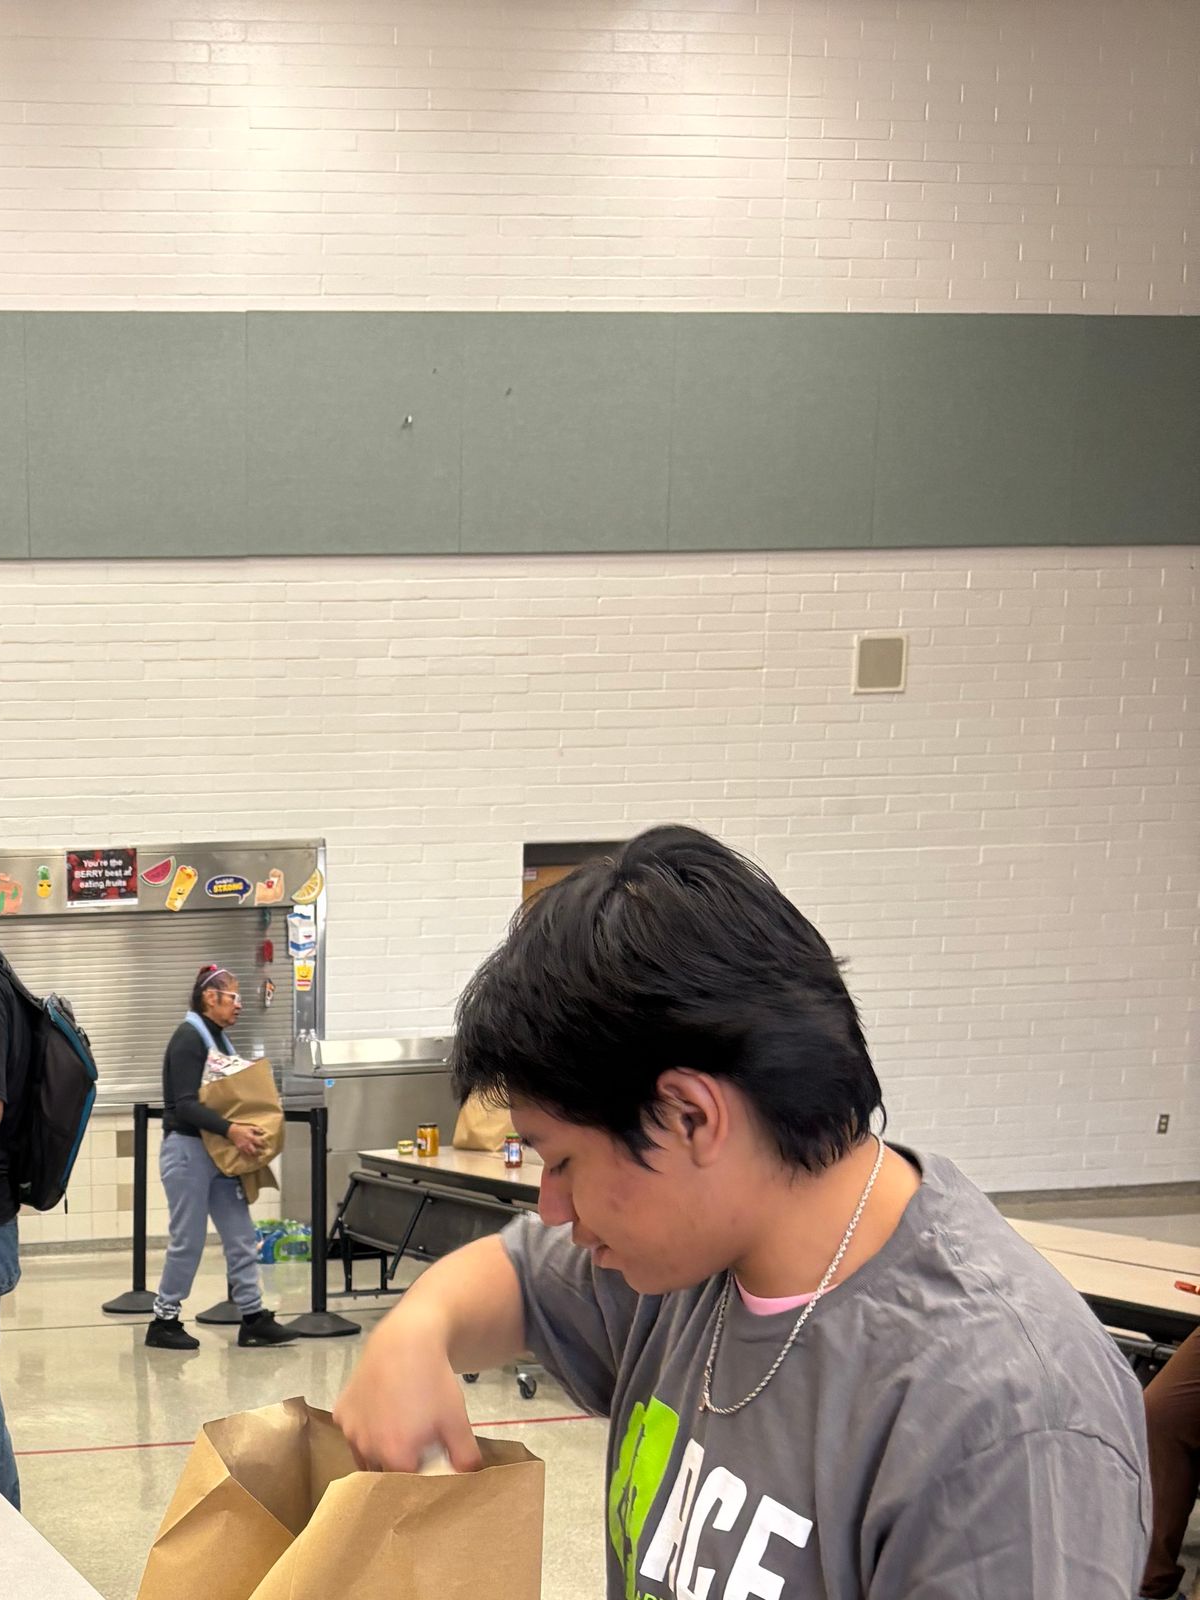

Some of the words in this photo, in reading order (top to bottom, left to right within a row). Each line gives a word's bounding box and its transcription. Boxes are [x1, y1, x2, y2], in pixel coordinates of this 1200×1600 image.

[83, 859, 108, 867] You're
[74, 869, 103, 878] BERRY
[104, 869, 122, 877] best
[79, 880, 105, 889] eating
[105, 879, 127, 887] fruits
